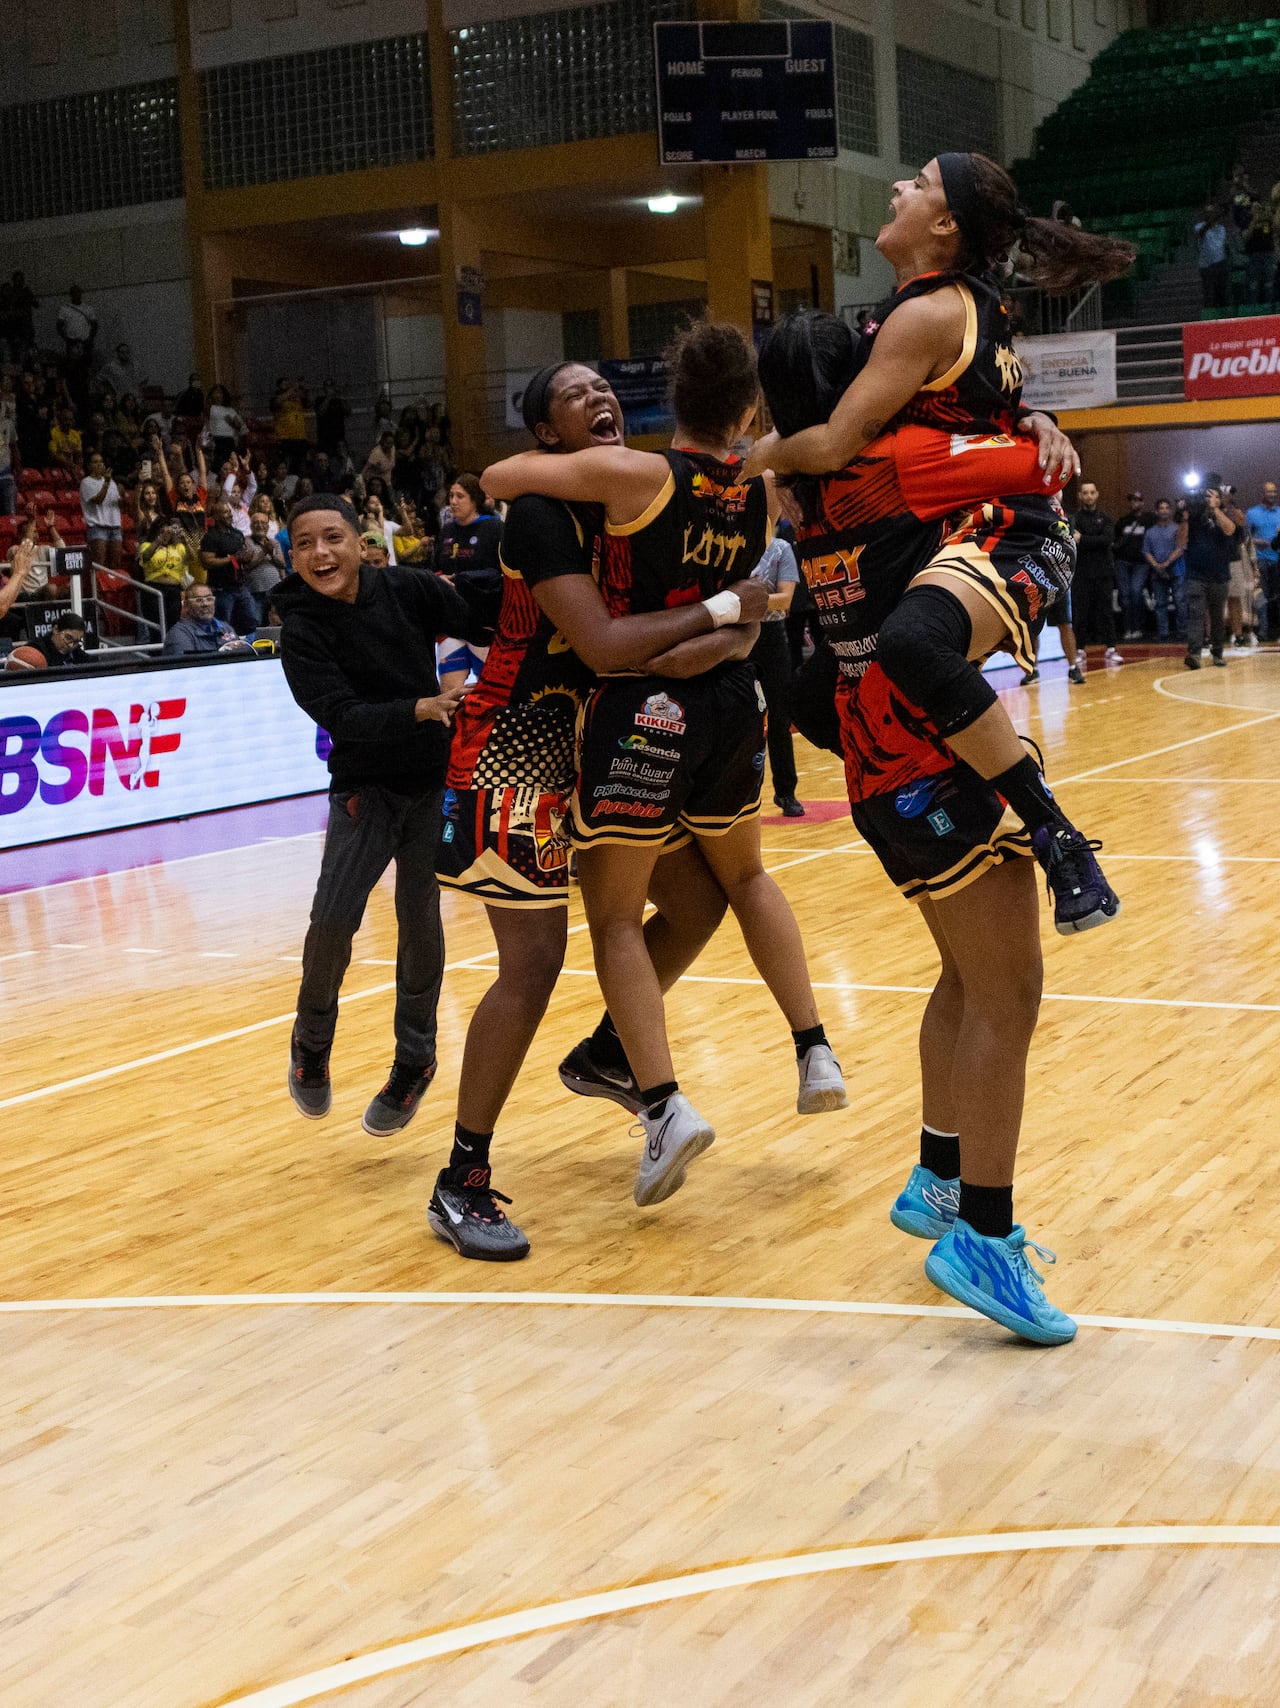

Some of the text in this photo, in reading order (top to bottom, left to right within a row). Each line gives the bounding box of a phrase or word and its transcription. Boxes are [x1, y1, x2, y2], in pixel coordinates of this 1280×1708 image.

[667, 61, 705, 75] HOME
[785, 58, 827, 73] GUEST
[731, 68, 763, 78] PERIOD
[663, 112, 692, 122] FOULS
[721, 110, 779, 120] PLAYER FOUL
[805, 108, 834, 118] FOULS
[665, 151, 694, 161] SCORE
[807, 147, 835, 157] SCORE
[1058, 366, 1098, 377] BUENA
[682, 521, 747, 572] LOTT
[64, 552, 83, 561] ARENA
[636, 715, 685, 734] KIKUET
[620, 734, 681, 760] Presencia
[611, 757, 675, 780] Point Guard
[591, 799, 665, 818] Pueblo
